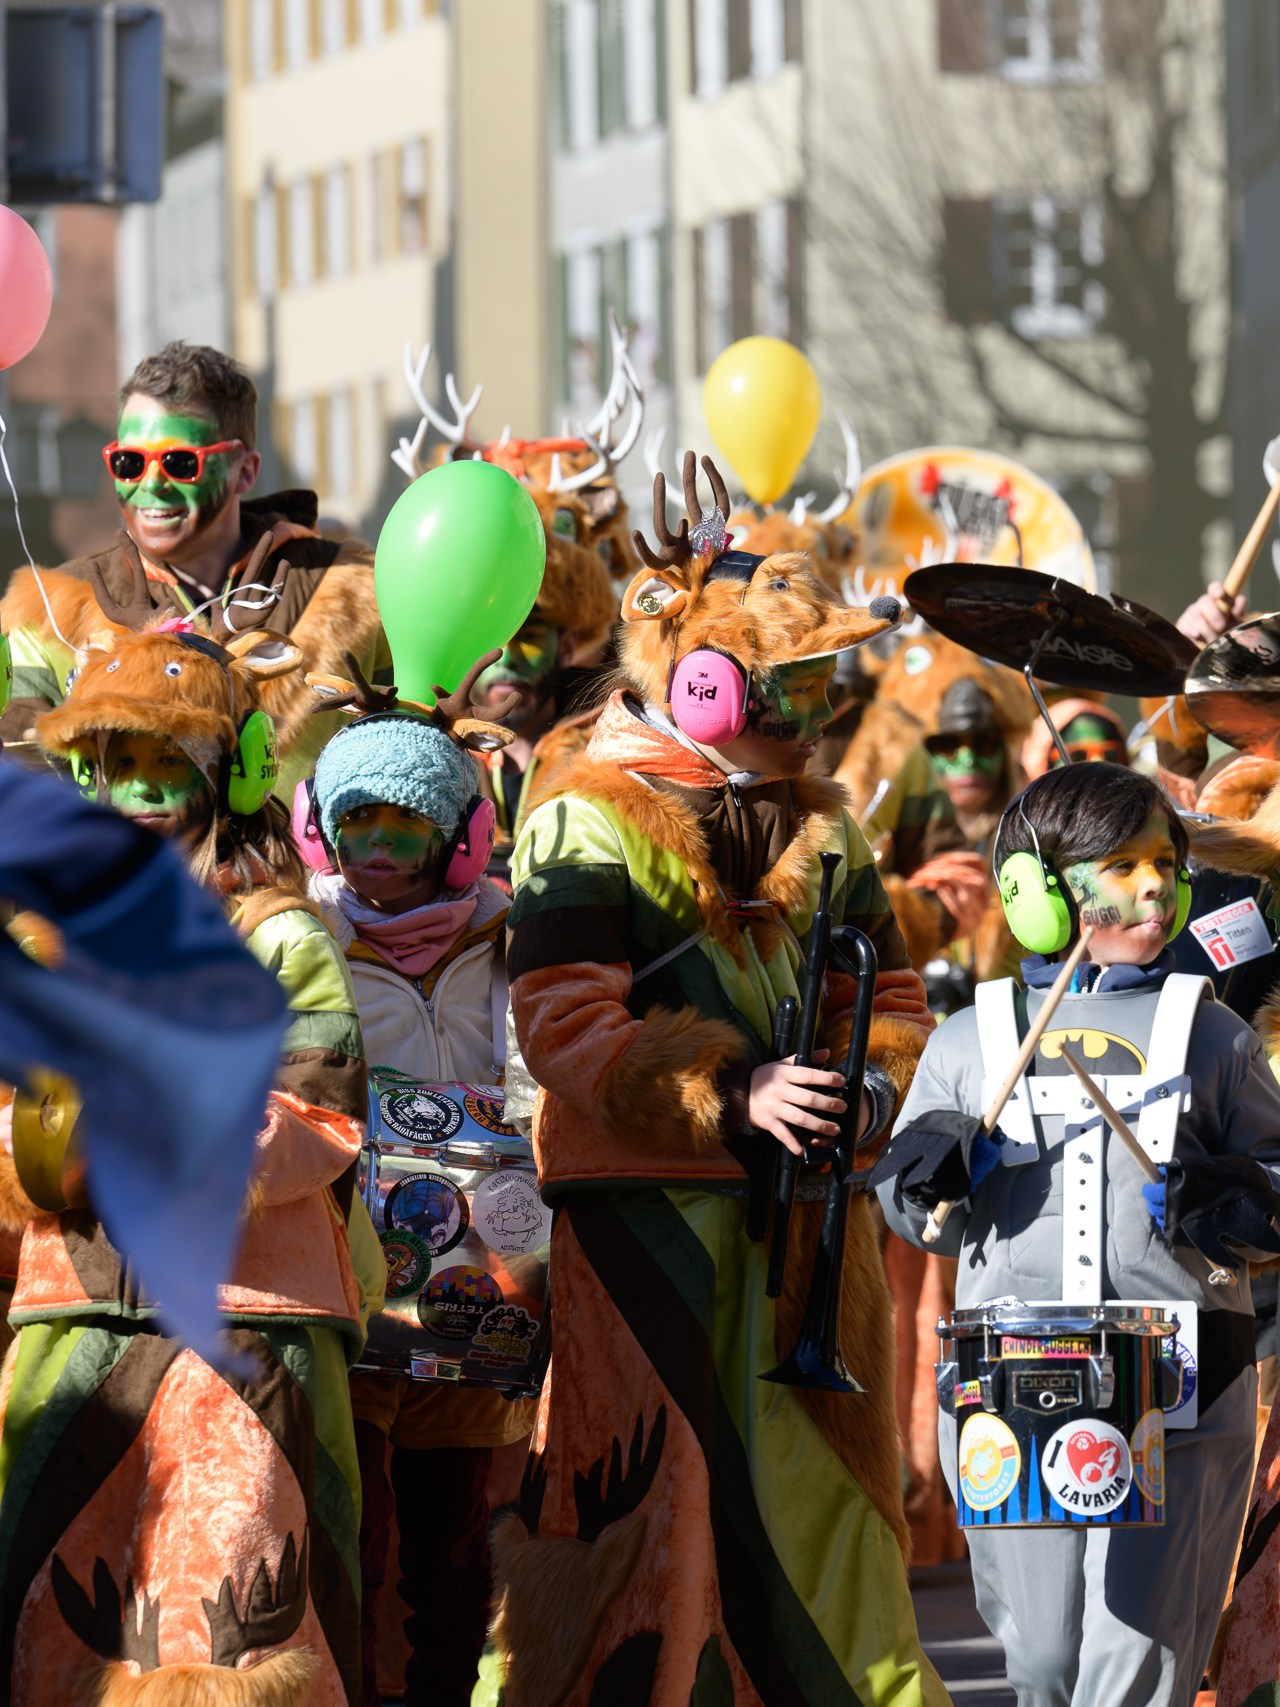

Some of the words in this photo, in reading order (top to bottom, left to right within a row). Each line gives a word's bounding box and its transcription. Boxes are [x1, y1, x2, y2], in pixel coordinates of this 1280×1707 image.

[688, 682, 717, 701] kid
[1003, 880, 1019, 906] kid
[1226, 926, 1252, 940] Titten
[417, 1088, 432, 1096] ZUM
[434, 1302, 484, 1314] TETRIS
[1004, 1340, 1089, 1354] CHINDERGUGGE.CH
[1020, 1377, 1074, 1388] DIXON
[1047, 1439, 1063, 1469] I
[1058, 1476, 1126, 1508] LAVARIA
